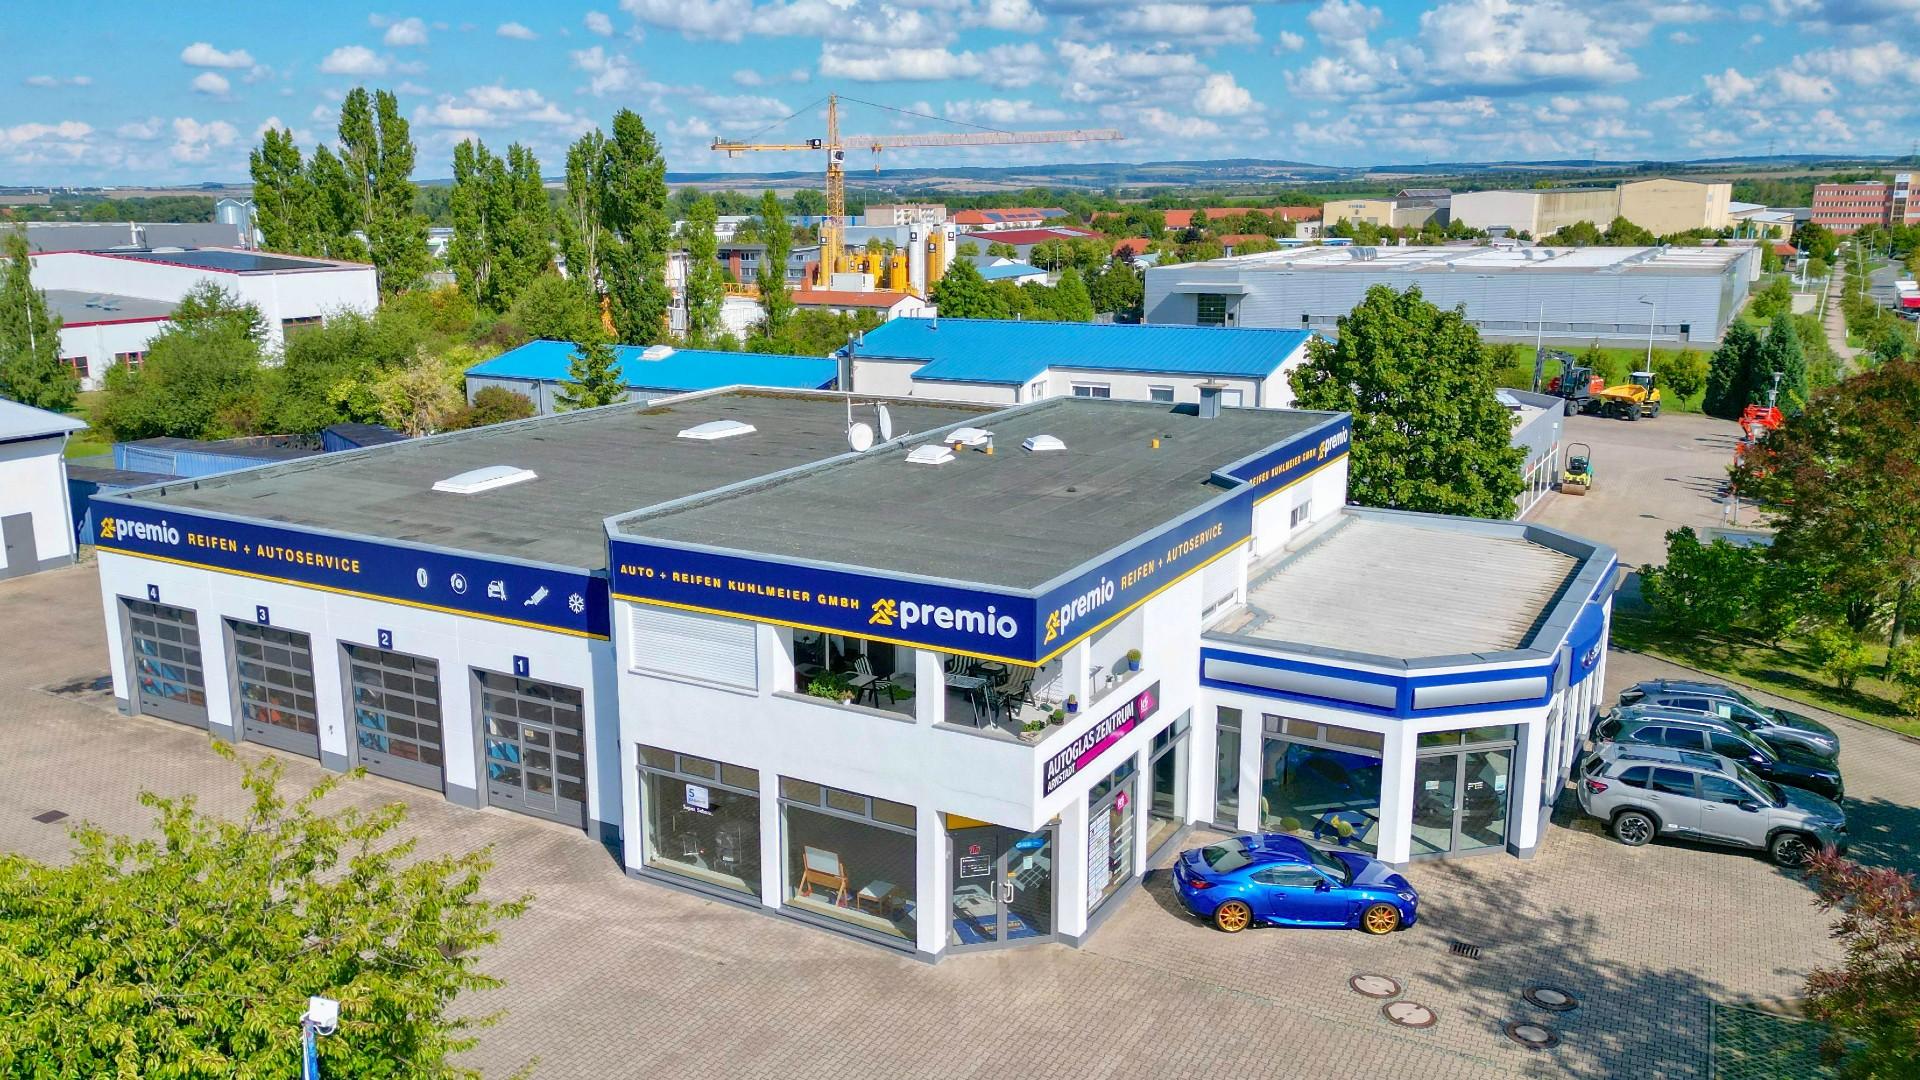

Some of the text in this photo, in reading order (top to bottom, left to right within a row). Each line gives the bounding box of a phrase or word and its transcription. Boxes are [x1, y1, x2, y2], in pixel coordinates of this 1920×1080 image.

[1325, 426, 1348, 457] premio
[116, 519, 179, 545] premio
[188, 533, 237, 552] REIFEN
[257, 545, 359, 573] AUTOSERVICE
[149, 588, 157, 599] 4
[1060, 577, 1115, 635] premio
[1121, 560, 1155, 591] REIFEN
[1167, 523, 1223, 563] AUTOSERVICE
[260, 609, 266, 621] 3
[620, 564, 654, 577] AUTO
[673, 572, 721, 588] REIFEN
[728, 581, 810, 601] KUHLMEIER
[818, 594, 859, 609] GMBH
[900, 601, 1017, 638] premio
[382, 633, 389, 645] 2
[518, 660, 524, 672] 1
[1048, 701, 1134, 779] AUTOGLAS ZENTRUM
[1048, 763, 1075, 793] ARNSTADT
